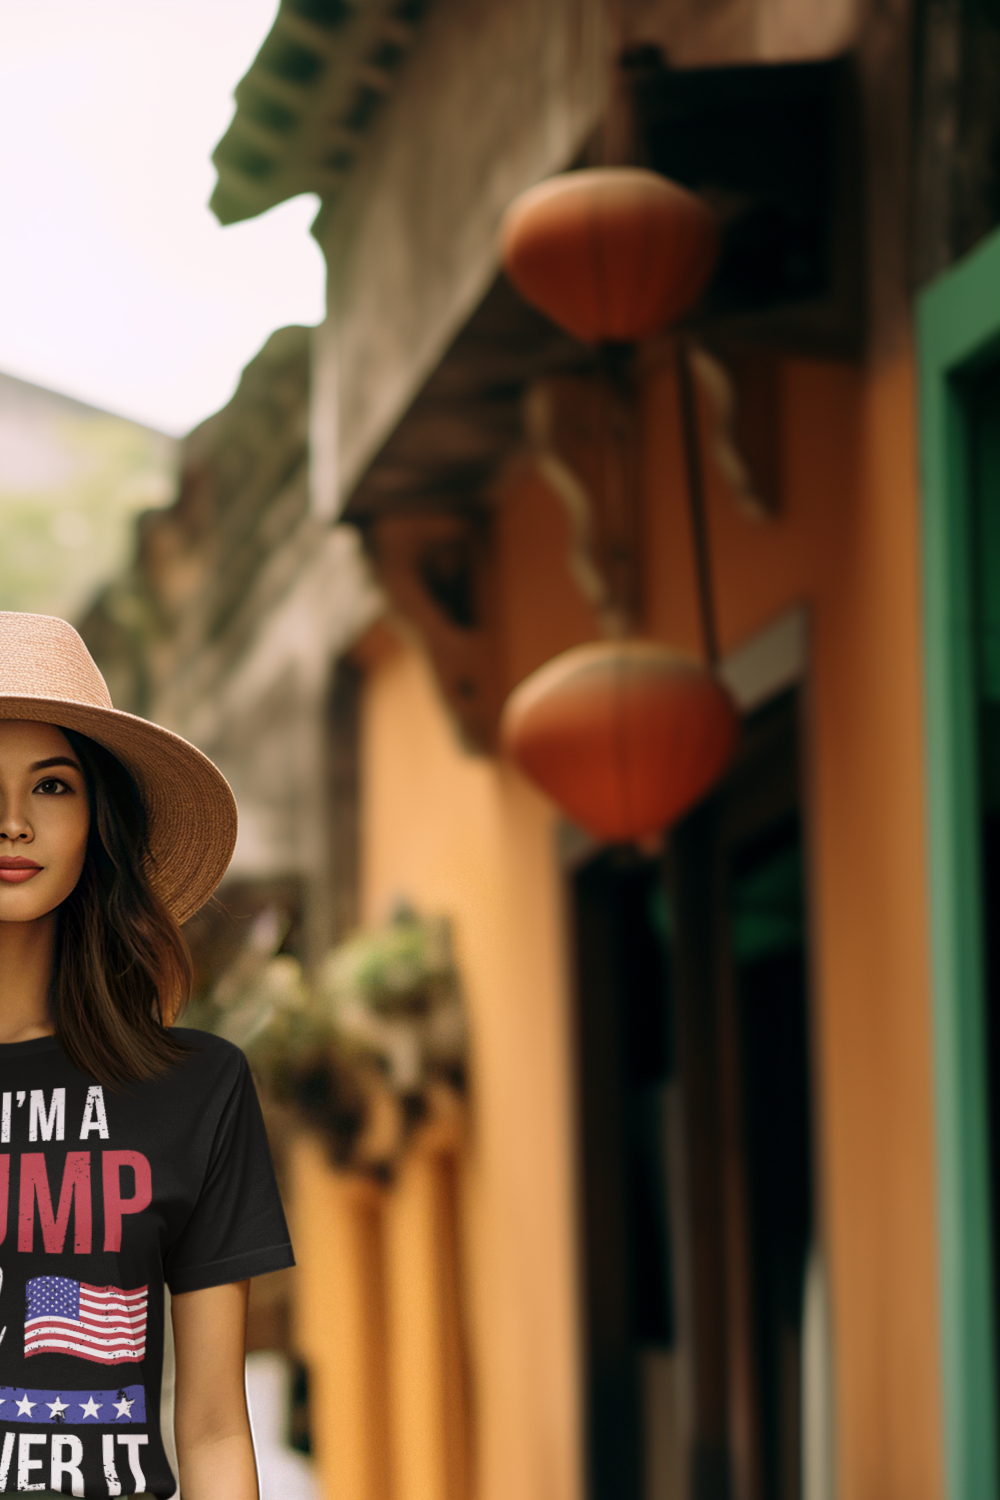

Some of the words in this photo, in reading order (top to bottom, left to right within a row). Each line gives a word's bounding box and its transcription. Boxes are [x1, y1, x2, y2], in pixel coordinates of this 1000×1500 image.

[1, 1087, 66, 1143] I'M
[79, 1085, 110, 1141] A
[101, 1433, 149, 1498] IT
